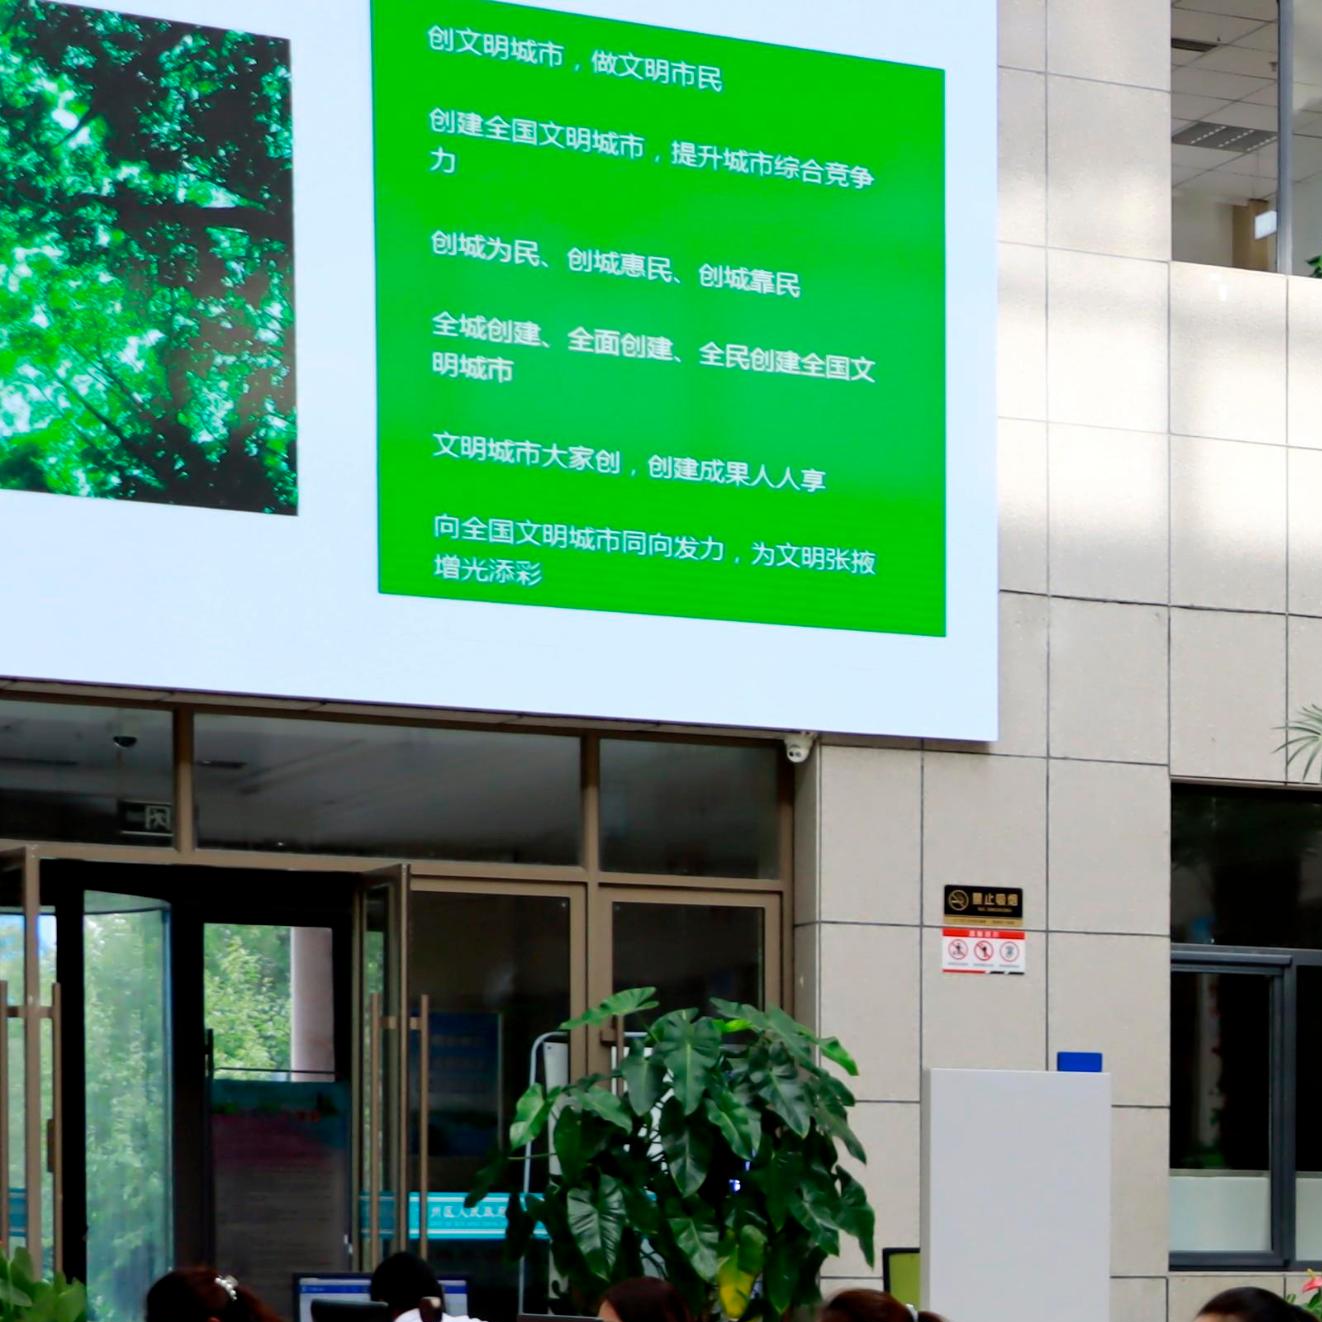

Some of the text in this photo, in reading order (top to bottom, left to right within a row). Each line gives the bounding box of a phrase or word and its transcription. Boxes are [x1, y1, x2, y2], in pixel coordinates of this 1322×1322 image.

[427, 25, 723, 92] 创文明城市，做文明市民
[429, 107, 874, 189] 创建全国文明城市，提升城市综合竞争
[430, 148, 457, 174] 力
[431, 230, 800, 298] 创城为民、创城惠民、创城靠民
[432, 311, 875, 383] 全城创建、全面创建、全民创建全国文
[432, 353, 513, 383] 明城市
[433, 432, 826, 492] 文明城市大家创，创建成果人人享
[434, 514, 876, 576] 向全国文明城市同向发力，为文明张掖
[434, 555, 542, 587] 增光添彩
